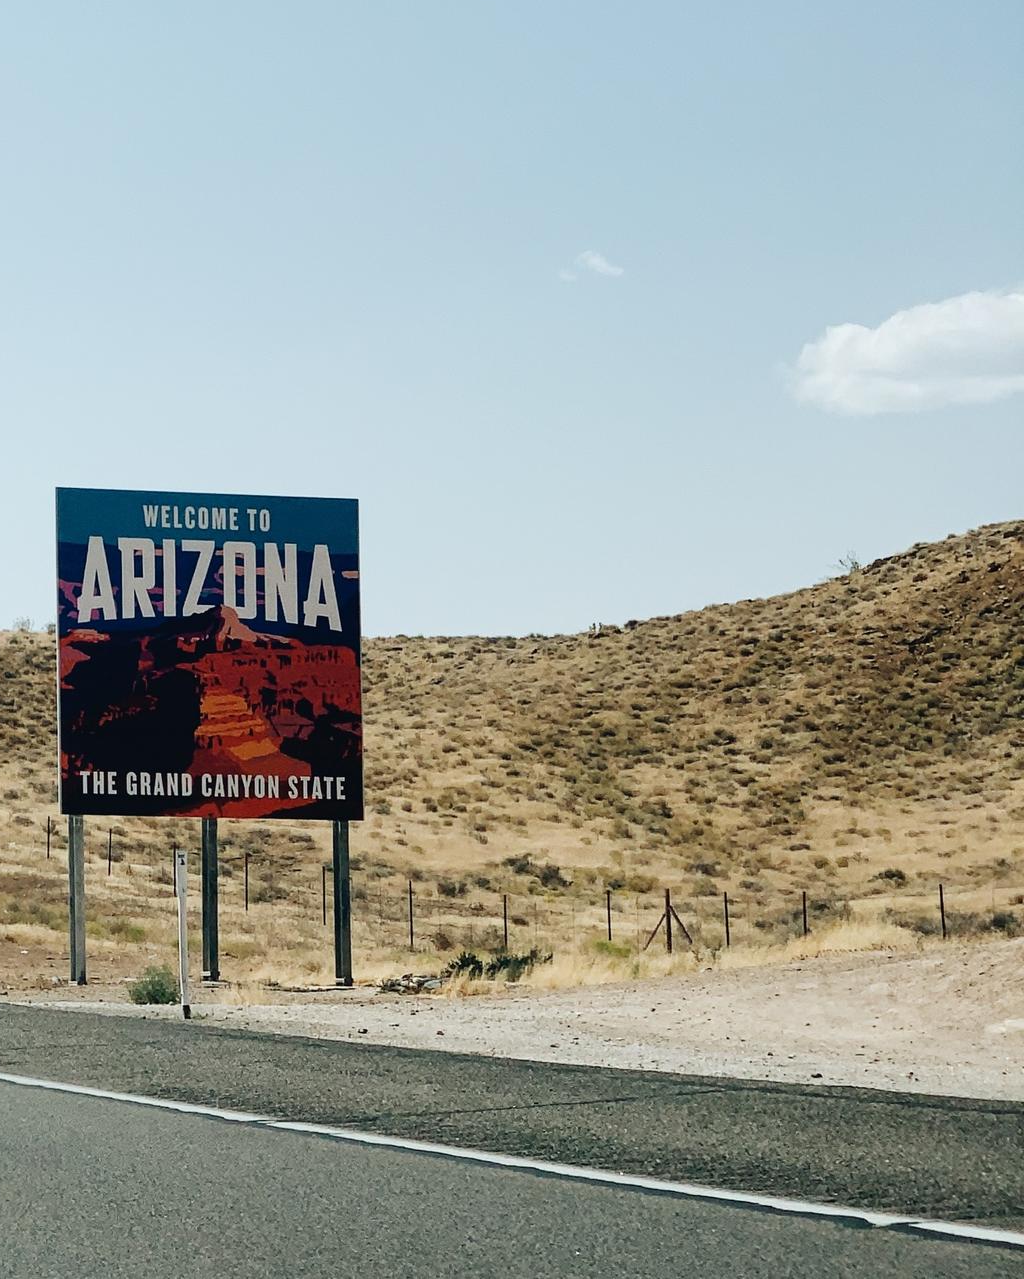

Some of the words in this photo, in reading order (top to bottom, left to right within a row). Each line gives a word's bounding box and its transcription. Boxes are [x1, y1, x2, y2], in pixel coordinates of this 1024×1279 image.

[142, 504, 239, 531] WELCOME
[247, 508, 271, 532] TO
[77, 535, 343, 632] ARIZONA
[79, 770, 118, 795] THE
[126, 771, 193, 797] GRAND
[201, 773, 280, 799] CANYON
[287, 775, 346, 801] STATE
